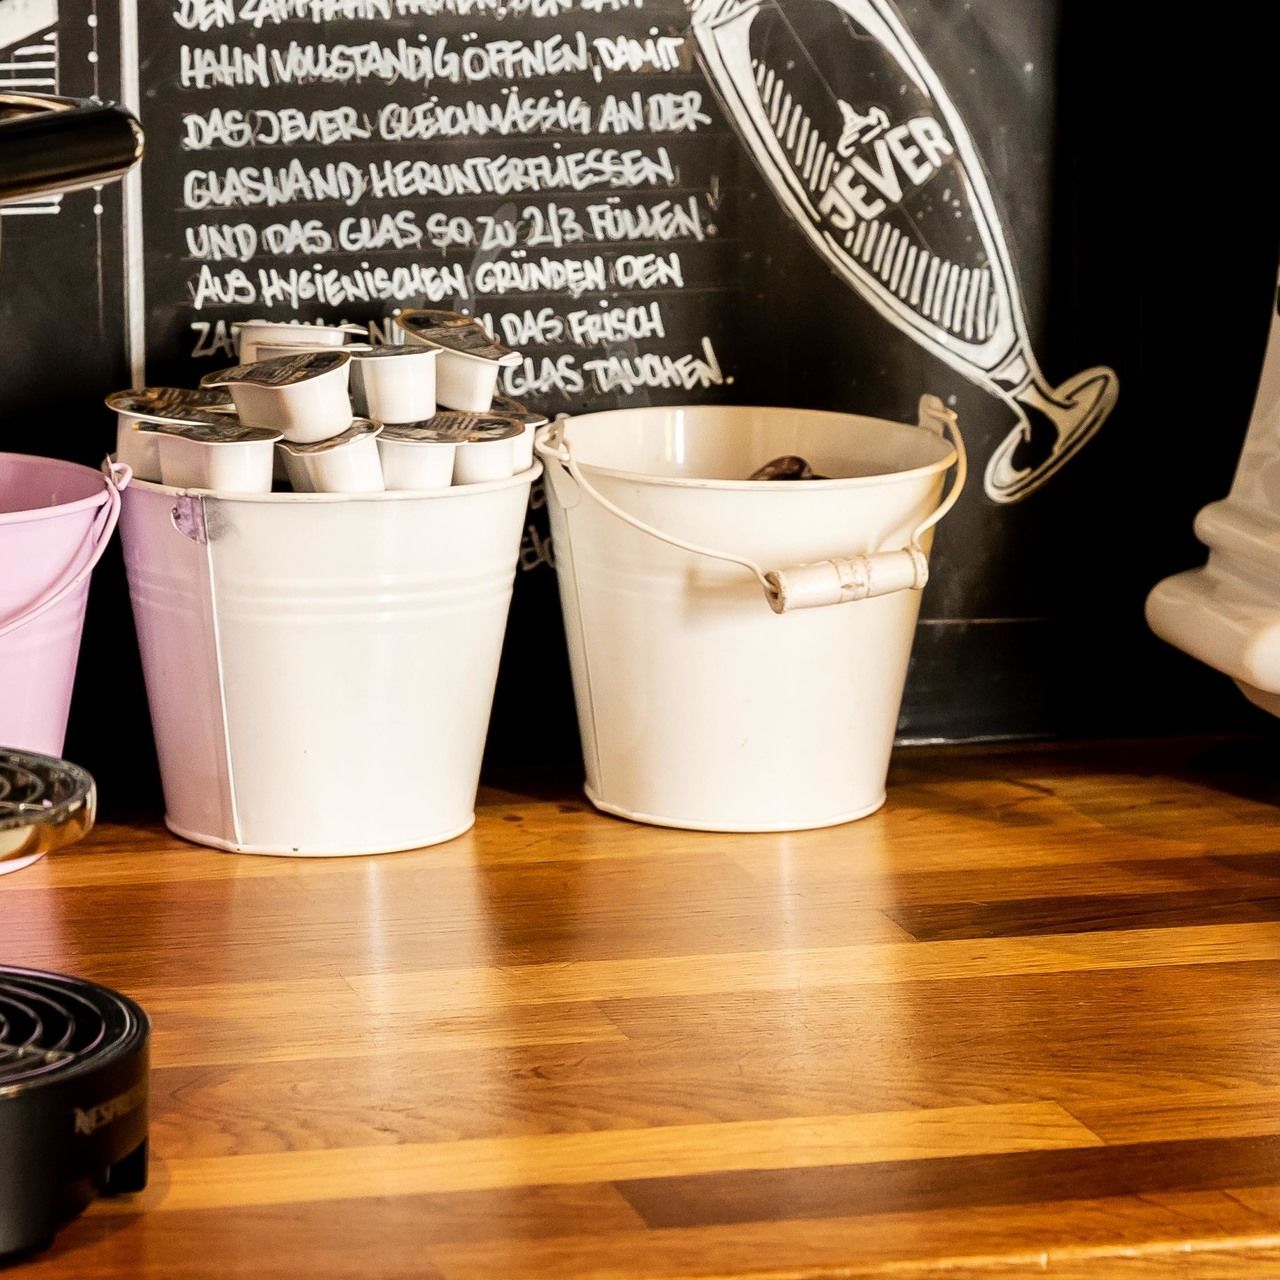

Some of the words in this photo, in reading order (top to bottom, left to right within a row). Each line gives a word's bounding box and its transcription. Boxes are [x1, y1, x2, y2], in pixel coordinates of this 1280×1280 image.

[179, 44, 270, 89] HAHN
[602, 25, 685, 72] DAMIT
[182, 108, 252, 151] DAS
[257, 106, 368, 146] JEVER
[379, 85, 591, 141] GLEICHMÄSSIG
[598, 92, 647, 134] AN
[649, 90, 712, 132] DER
[183, 158, 361, 208] GLASWAND
[369, 142, 675, 200] HERUNTERFLIESSEN
[820, 115, 954, 231] JEVER
[185, 223, 256, 263] UND
[262, 217, 332, 255] DAS
[339, 210, 420, 250] GLAS
[427, 213, 470, 249] SO
[477, 215, 517, 250] ZU
[524, 202, 578, 247] 2/3
[588, 195, 718, 243] FÜLLEN.
[191, 263, 256, 311] AUS
[260, 261, 471, 310] HYGIENISCHEN
[474, 249, 606, 295] GRÜNDEN
[619, 251, 685, 288] DEN
[502, 305, 563, 347] DAS
[568, 299, 665, 341] FRISCH
[502, 353, 584, 398] GLAS
[582, 337, 734, 390] TAUCHEN.
